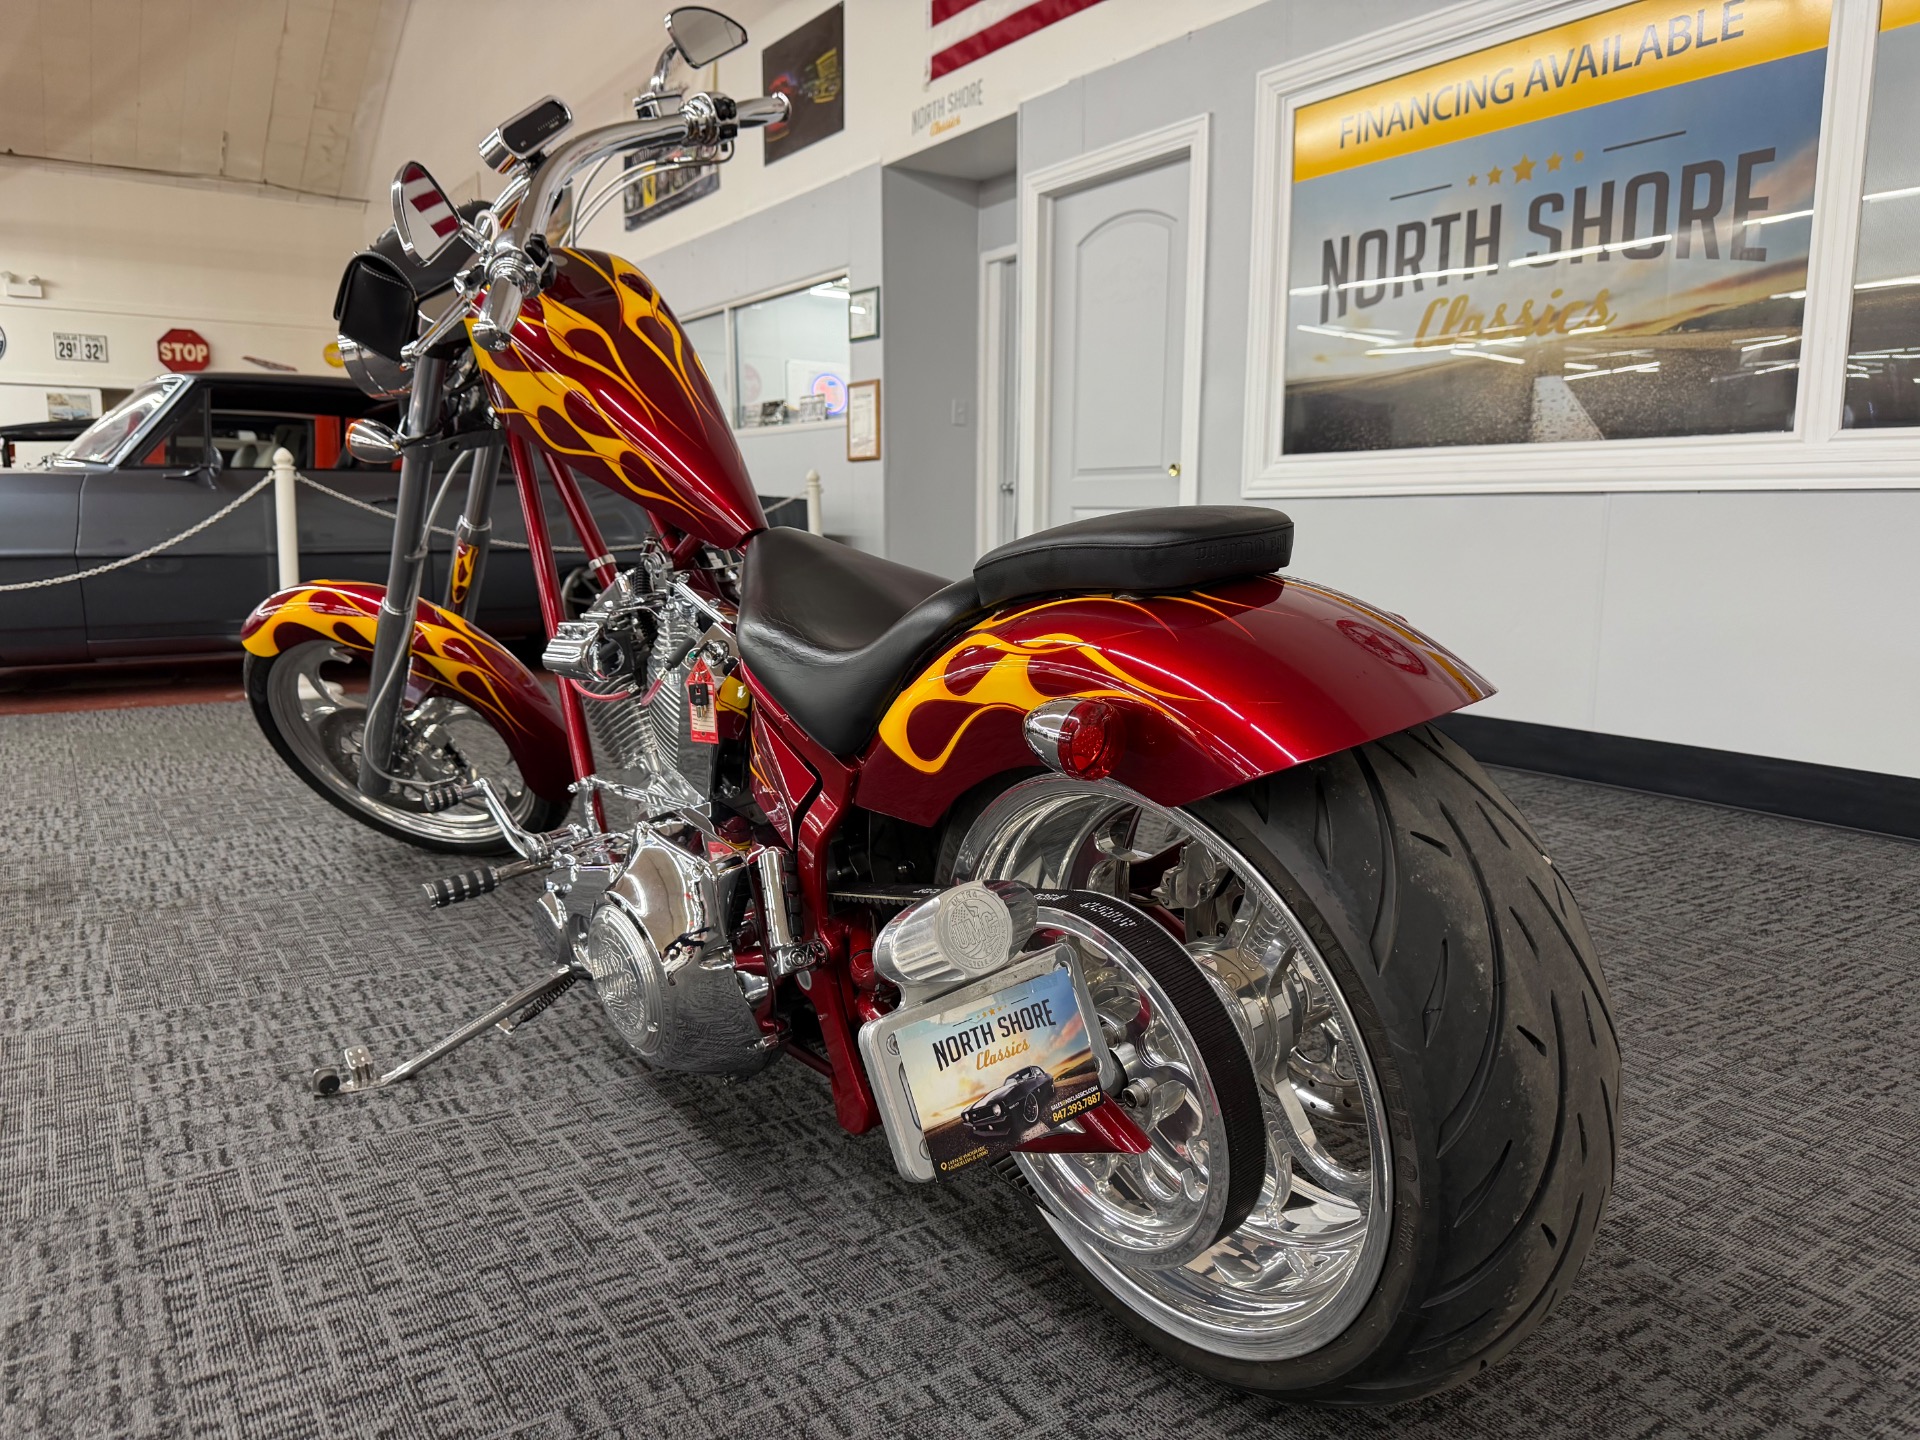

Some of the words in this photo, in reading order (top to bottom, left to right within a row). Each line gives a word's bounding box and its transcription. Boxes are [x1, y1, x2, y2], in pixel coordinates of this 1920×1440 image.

[1339, 67, 1515, 149] FINANCING
[1523, 0, 1746, 97] AVAILABLE
[911, 97, 946, 137] NORTH
[947, 78, 983, 113] SHORE
[1319, 203, 1502, 325] NORTH
[1526, 147, 1777, 269] SHORE
[1413, 287, 1618, 349] Classics
[160, 342, 208, 363] STOP
[932, 1021, 996, 1072] NORTH
[997, 998, 1057, 1038] SHORE
[976, 1038, 1031, 1071] Classics
[1052, 1091, 1101, 1122] 847.393.7887
